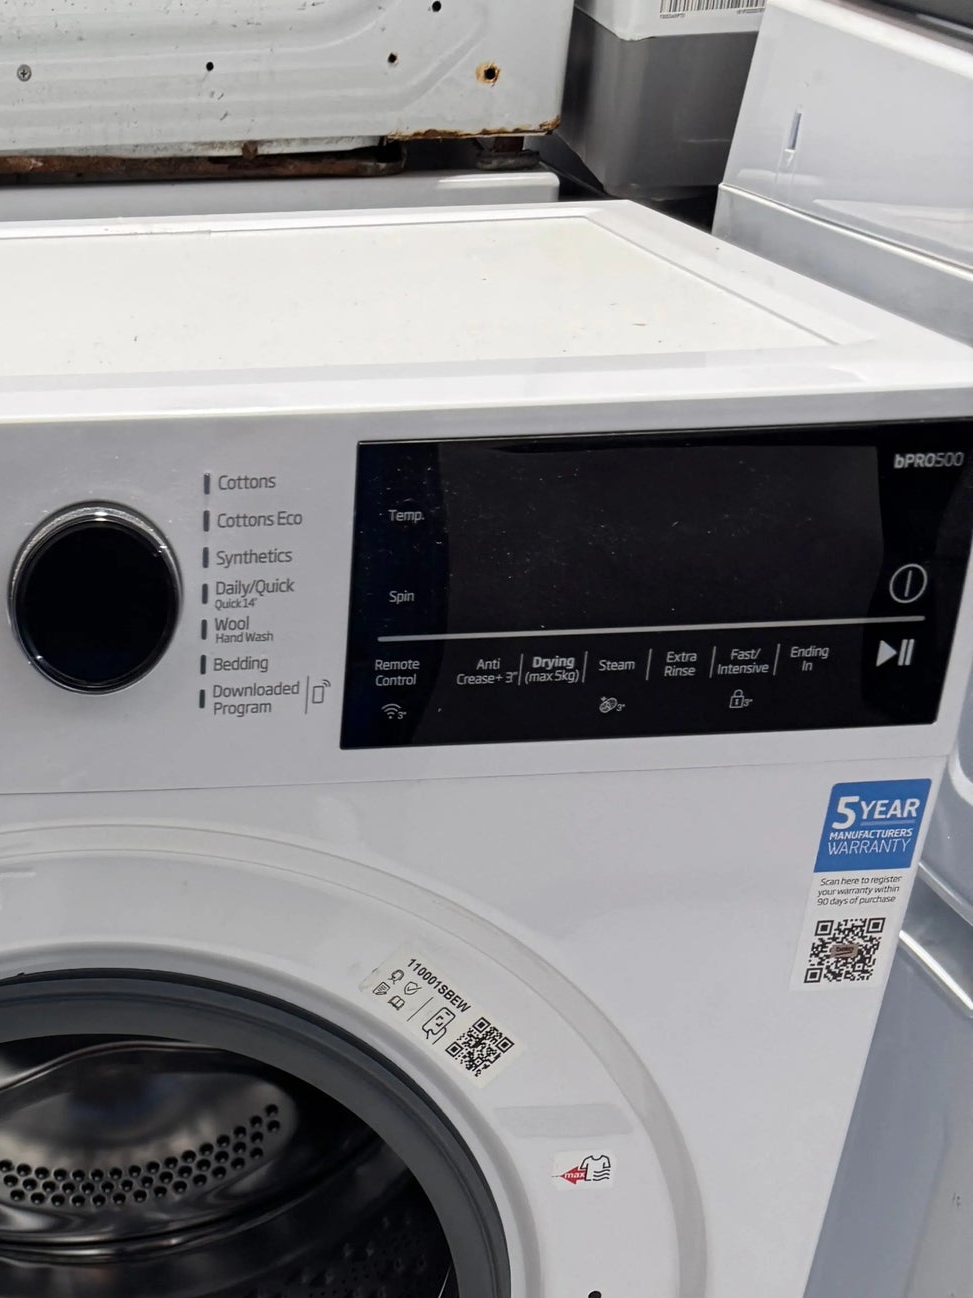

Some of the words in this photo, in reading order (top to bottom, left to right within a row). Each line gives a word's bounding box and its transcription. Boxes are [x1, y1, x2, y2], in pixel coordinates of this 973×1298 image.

[893, 452, 964, 469] bPRO500
[218, 474, 276, 490] Cottons
[217, 512, 274, 528] Cottons
[277, 510, 303, 526] Eco
[388, 509, 425, 524] Temp.
[216, 548, 293, 569] Synthetics
[216, 578, 296, 598] Daily/Quick
[388, 590, 415, 605] Spin
[214, 599, 242, 611] Quick
[214, 616, 250, 631] Wool
[216, 632, 244, 644] Hand
[246, 630, 274, 642] Wash
[666, 651, 698, 663] Extra
[730, 648, 762, 660] Fast/
[790, 646, 830, 660] Ending
[213, 656, 269, 673] Bedding
[374, 659, 420, 671] Remote
[476, 658, 501, 670] Anti
[532, 655, 576, 670] Drying
[598, 659, 636, 672] Steam
[717, 662, 770, 675] Intensive
[802, 660, 813, 671] In
[664, 665, 696, 677] Rinse
[375, 674, 417, 686] Control
[456, 672, 504, 686] Crease+
[212, 680, 300, 698] Downloaded
[214, 701, 272, 718] Program
[831, 796, 860, 830] 5
[860, 798, 921, 820] YEAR
[829, 827, 913, 841] MANUFACTURERS
[828, 838, 912, 856] WARRANTY
[820, 878, 841, 886] Scan
[841, 877, 860, 885] here
[870, 876, 903, 886] register
[818, 888, 837, 898] your
[837, 886, 873, 895] warranty
[874, 884, 900, 894] within
[817, 898, 829, 906] 90
[829, 896, 848, 906] days
[849, 896, 860, 905] of
[859, 895, 896, 905] purchase
[407, 958, 472, 1013] 110001SBEW
